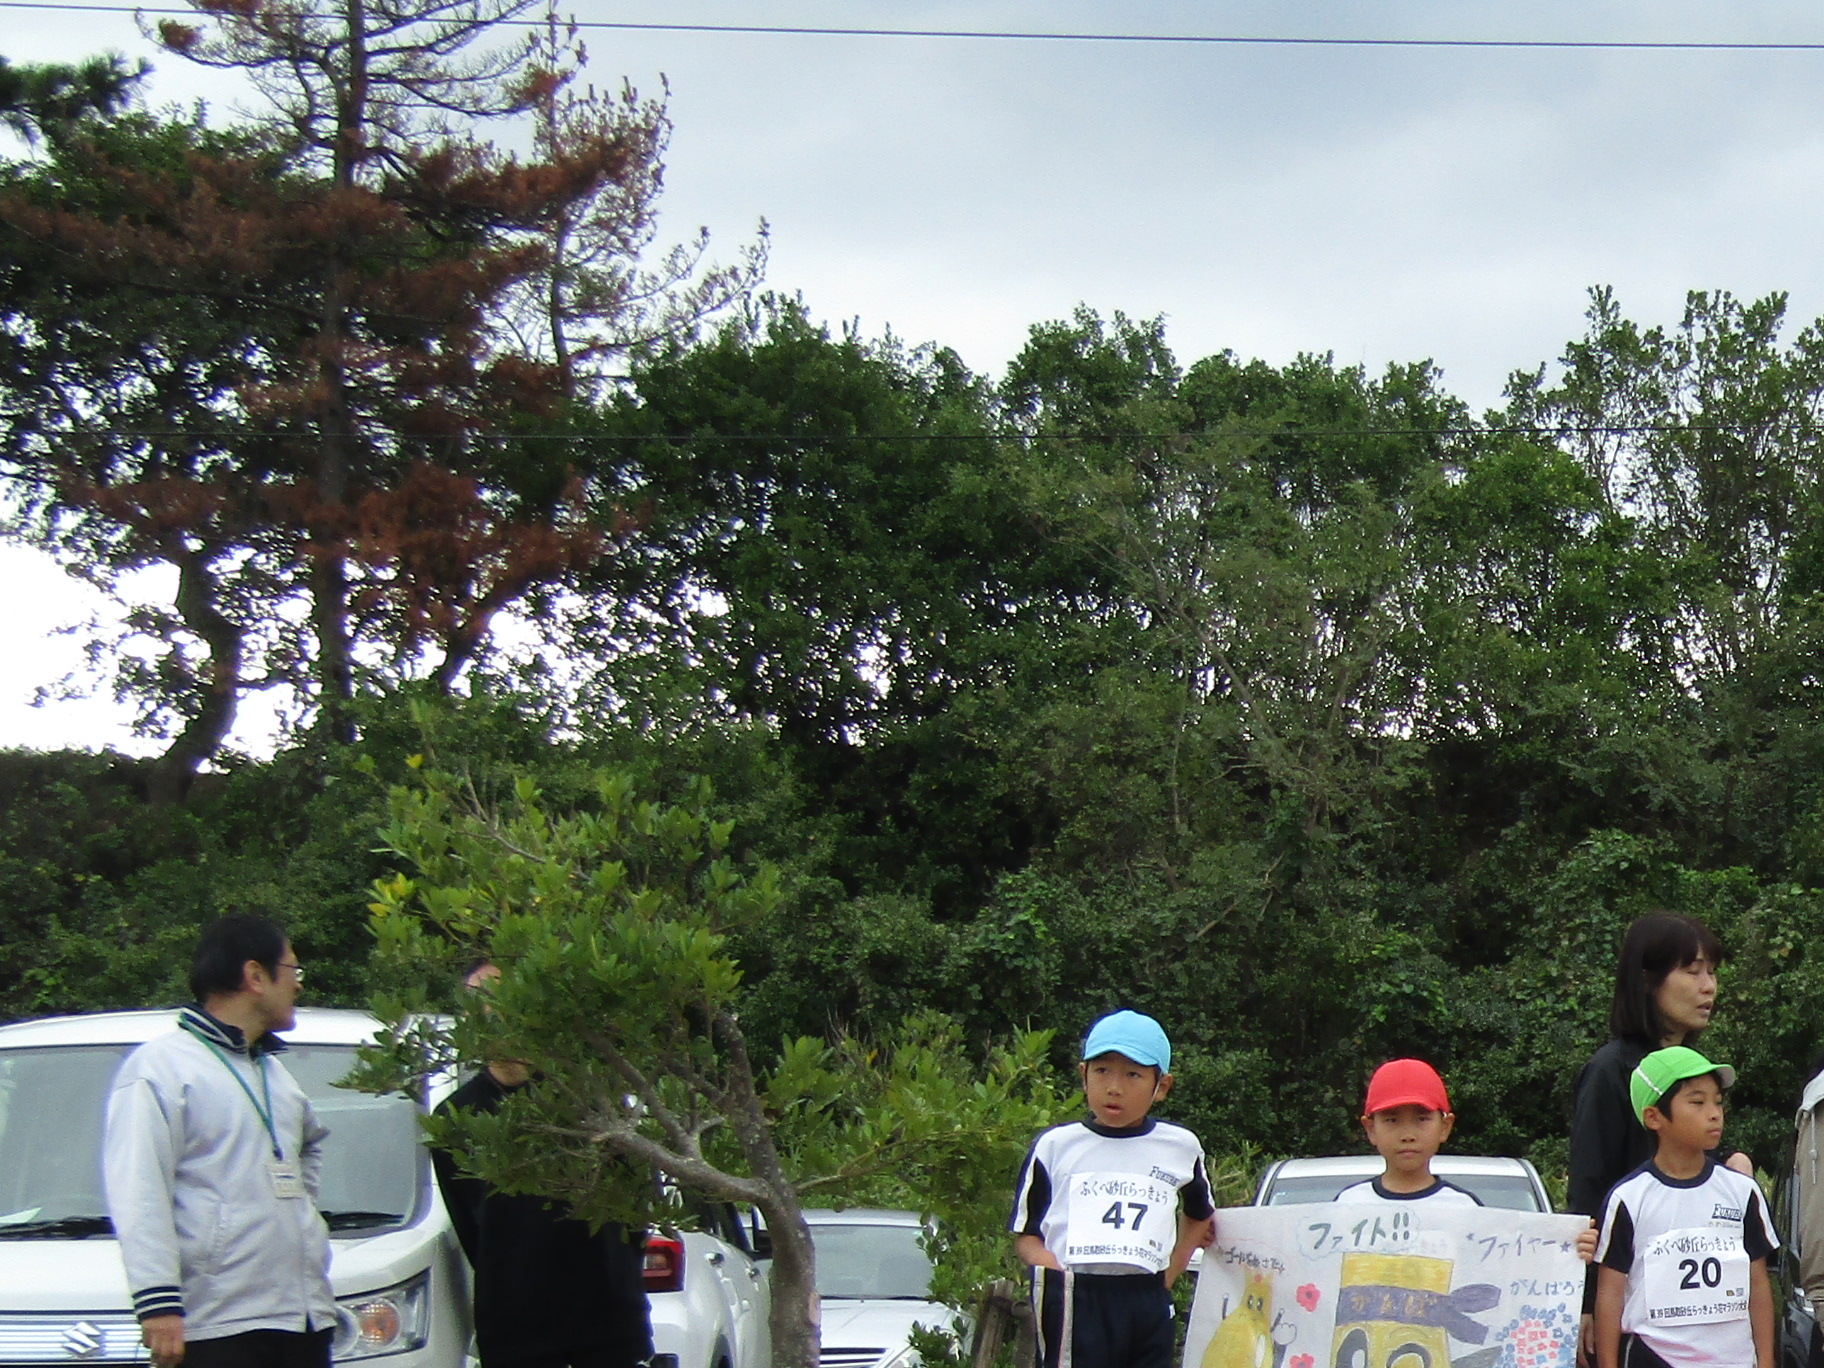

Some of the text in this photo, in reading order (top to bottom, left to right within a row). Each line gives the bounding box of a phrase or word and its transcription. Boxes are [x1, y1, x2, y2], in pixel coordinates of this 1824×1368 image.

[1080, 1180, 1168, 1206] ふくべ砂丘らっきょう
[1102, 1201, 1149, 1231] 47
[1478, 1233, 1557, 1262] ファイヤー
[1653, 1236, 1736, 1255] ふくべ砂丘らっきょう
[1678, 1257, 1722, 1290] 20
